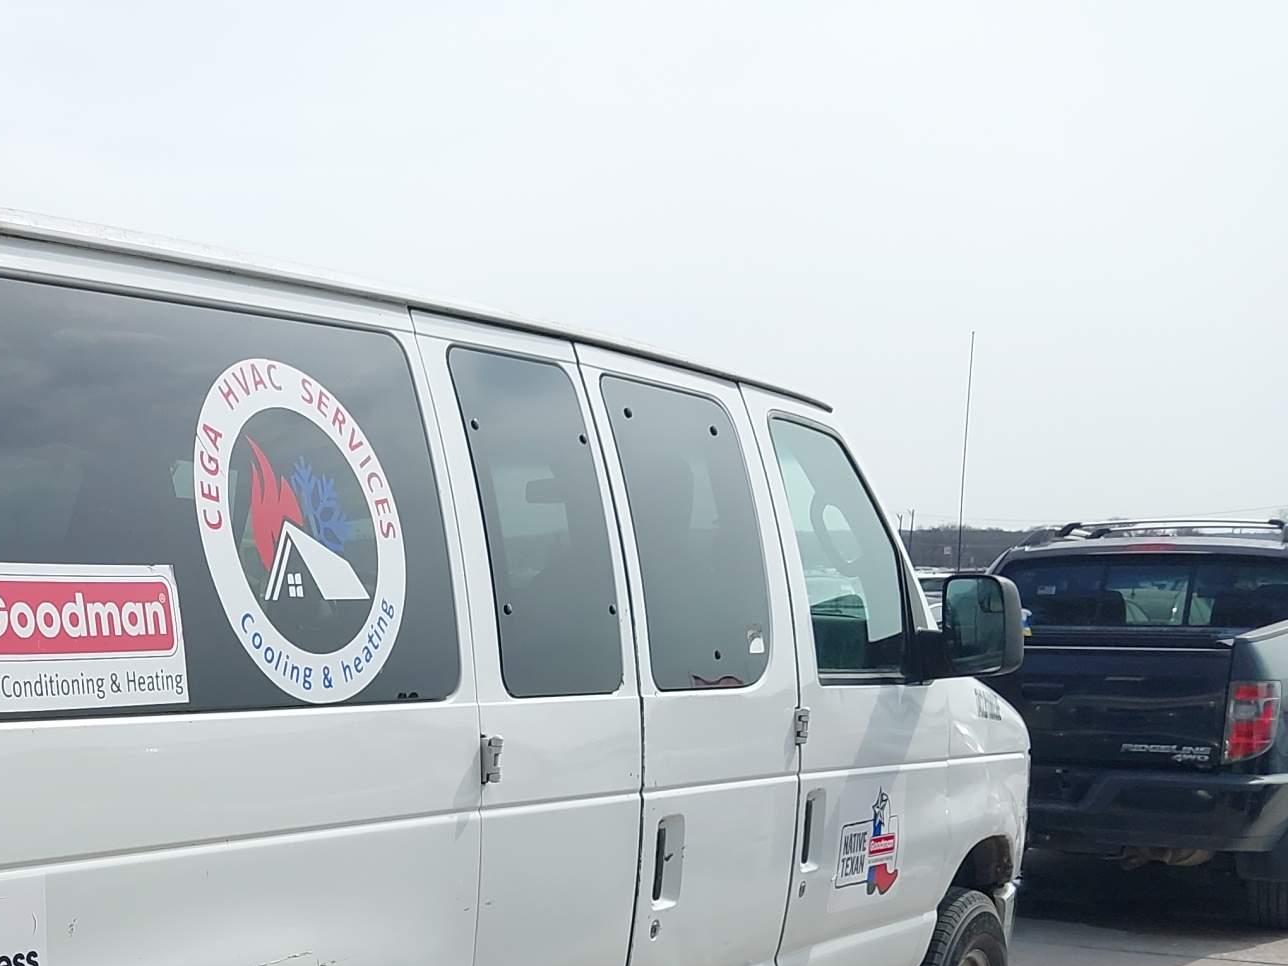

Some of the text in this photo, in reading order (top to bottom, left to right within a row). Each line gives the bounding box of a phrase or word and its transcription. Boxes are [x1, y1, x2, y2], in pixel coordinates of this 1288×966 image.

[199, 363, 396, 539] CEGA HVAC SERVICES
[241, 598, 394, 690] Cooling & heating
[2, 672, 105, 699] Conditioning
[110, 673, 122, 693] &
[126, 669, 184, 695] Heating
[843, 832, 867, 856] NATIVE
[841, 855, 865, 878] TEXAN
